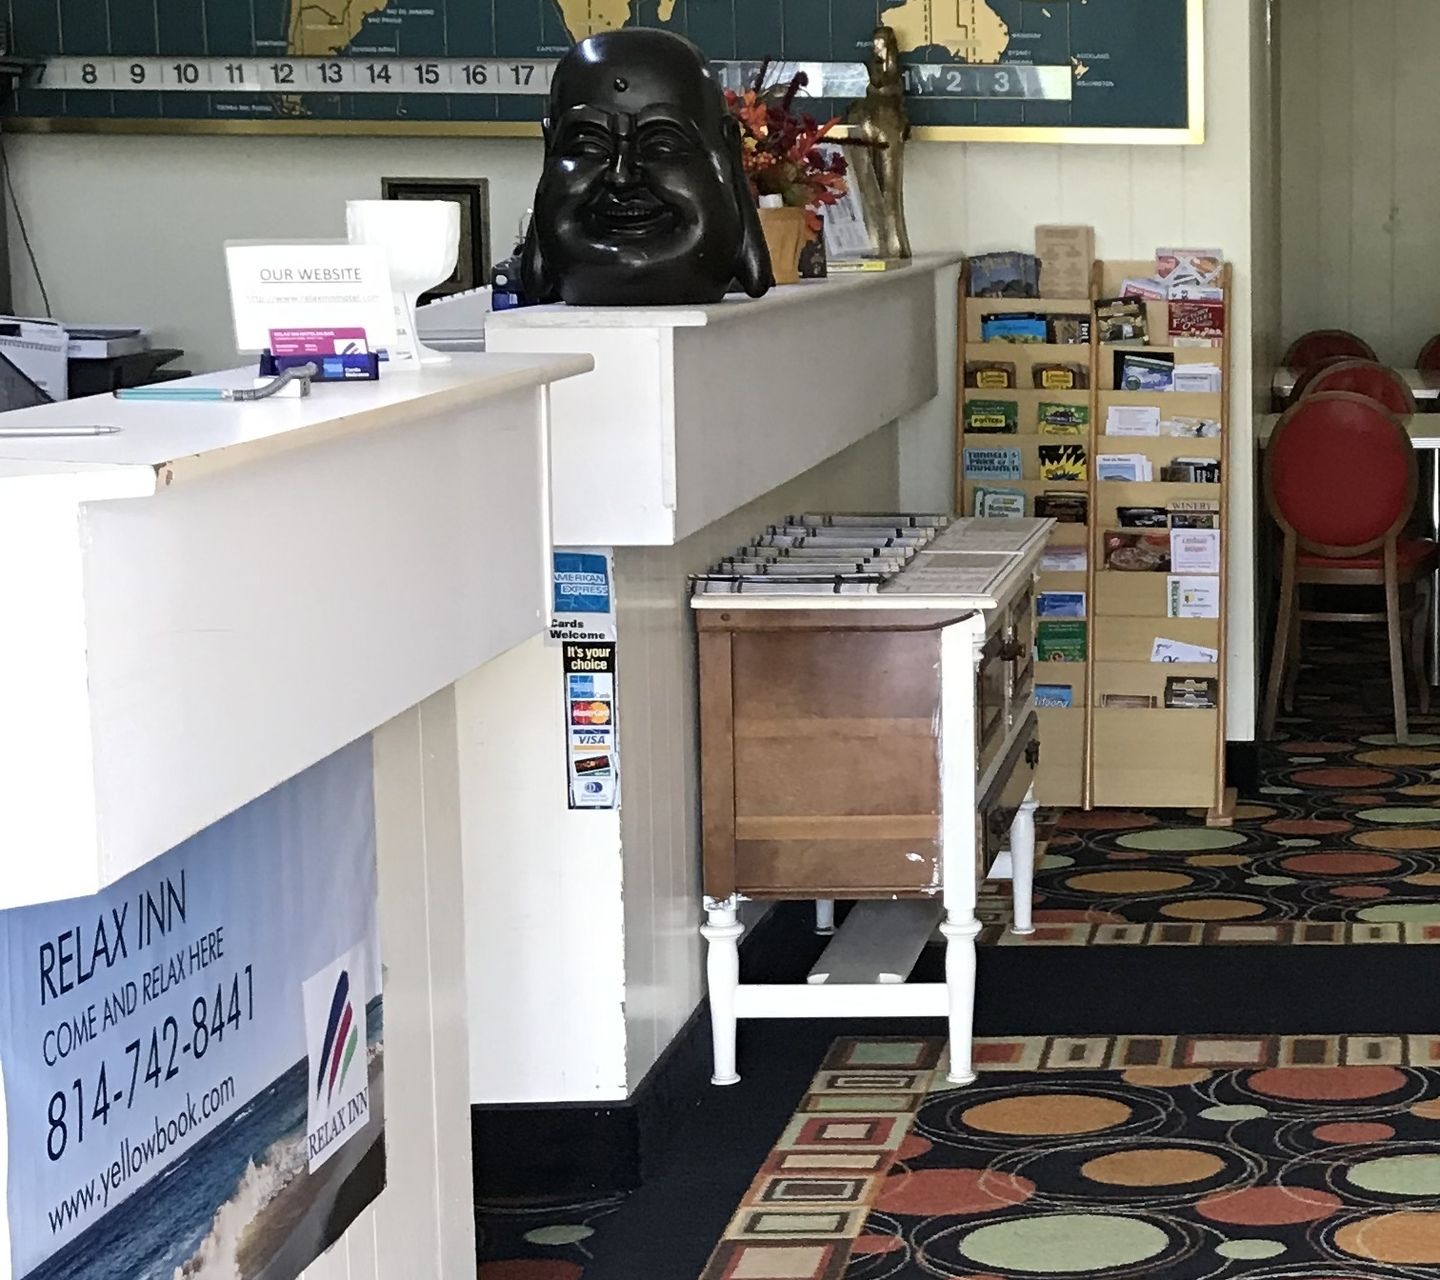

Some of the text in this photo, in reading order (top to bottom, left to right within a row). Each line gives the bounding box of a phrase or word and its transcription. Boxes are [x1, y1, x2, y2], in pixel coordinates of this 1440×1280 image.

[82, 63, 97, 84] 8
[130, 63, 145, 84] 9
[173, 63, 199, 84] 10
[225, 63, 244, 84] 11
[270, 63, 294, 84] 12
[318, 63, 343, 84] 13
[366, 63, 392, 84] 14
[414, 63, 440, 84] 15
[461, 64, 488, 85] 16
[510, 64, 535, 86] 17
[946, 71, 962, 93] 2
[994, 71, 1010, 93] 3
[259, 267, 363, 281] OUR WEBSITE
[1172, 501, 1212, 510] WINERY
[562, 585, 609, 594] EXPRESS
[551, 619, 584, 628] Cards
[549, 629, 606, 640] Welcome
[567, 646, 611, 659] It's your
[571, 658, 608, 670] choice
[578, 735, 606, 745] VISA
[39, 868, 187, 1006] RELAX INN
[43, 926, 224, 1067] COME AND RELAX HERE
[46, 963, 254, 1162] 814-742-8441
[308, 1086, 369, 1160] RELAX INN
[47, 1075, 236, 1236] www.yellowbook.com
